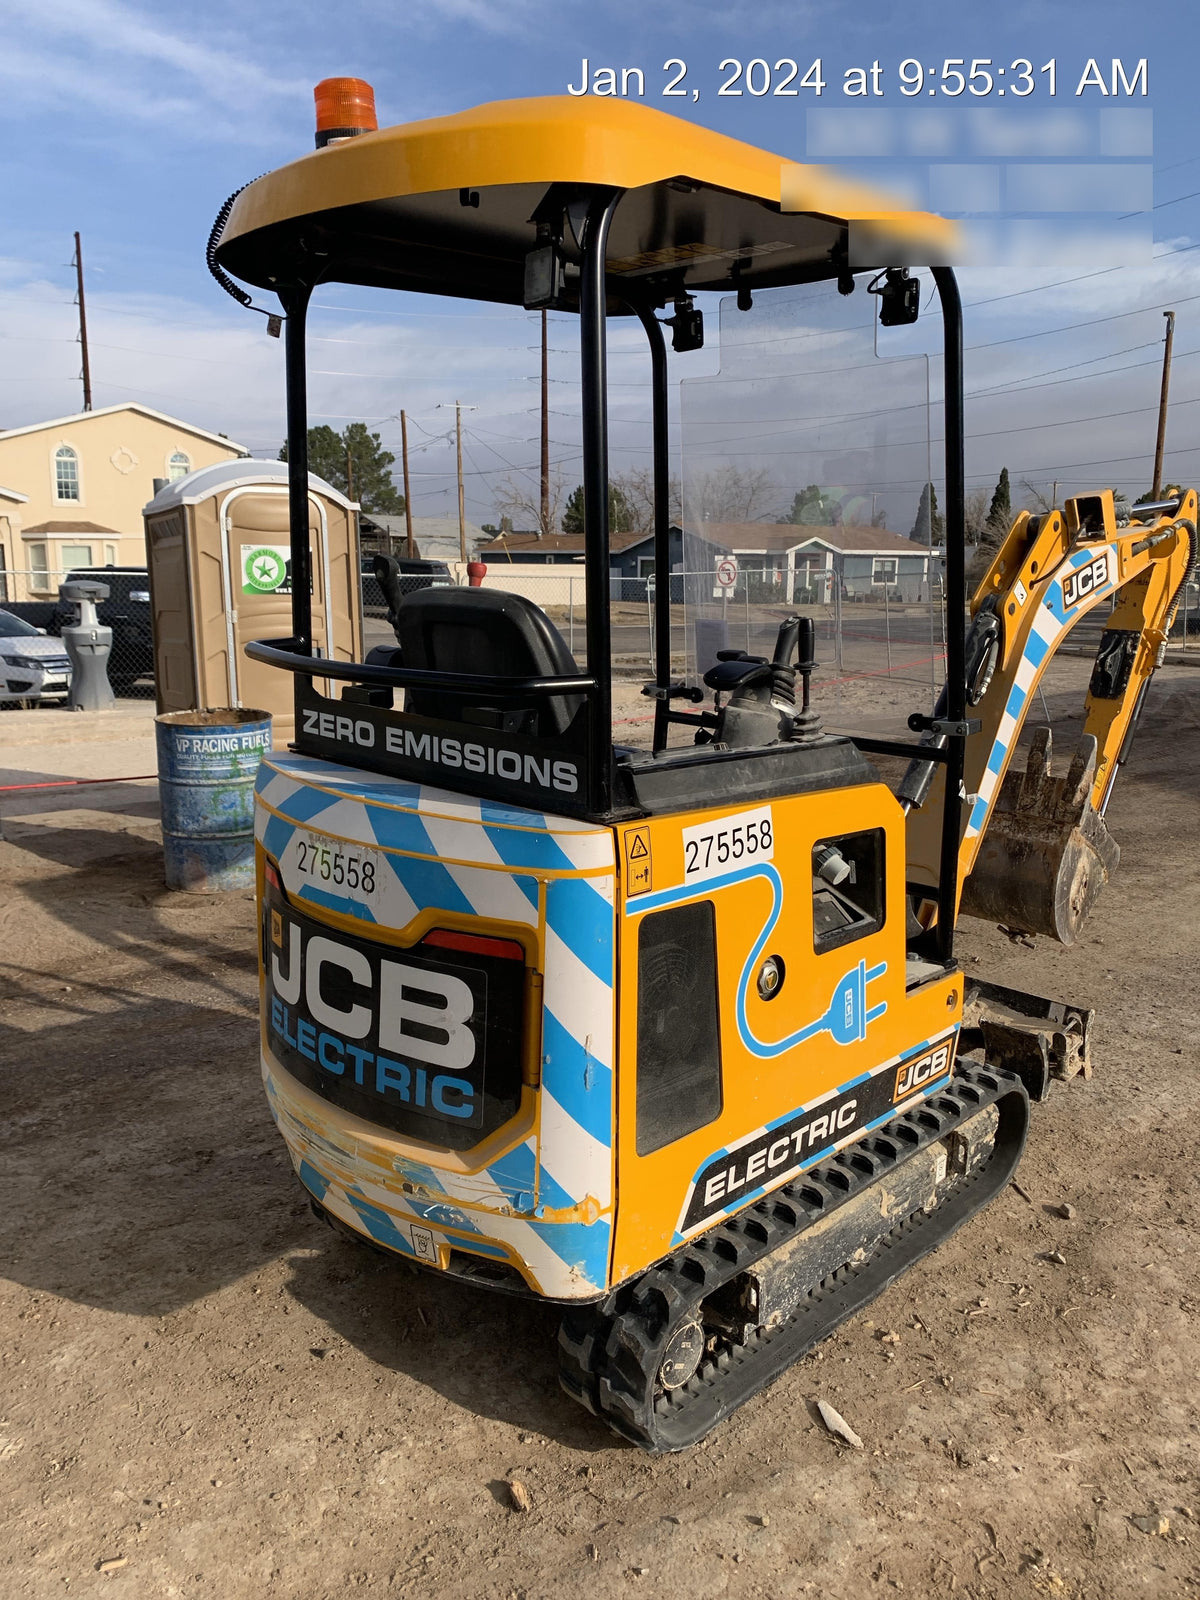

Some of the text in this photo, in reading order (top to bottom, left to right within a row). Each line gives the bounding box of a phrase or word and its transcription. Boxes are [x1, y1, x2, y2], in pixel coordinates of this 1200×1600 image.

[1064, 557, 1108, 606] JCB
[176, 738, 189, 753] VP
[193, 738, 239, 753] RACING
[242, 733, 270, 750] FUELS
[302, 709, 579, 794] ZERO EMISSIONS
[297, 841, 376, 894] 275558
[685, 819, 773, 874] 275558
[271, 921, 476, 1070] JCB
[271, 994, 475, 1119] ELECTRIC
[897, 1046, 949, 1095] JCB
[704, 1099, 858, 1207] ELECTRIC
